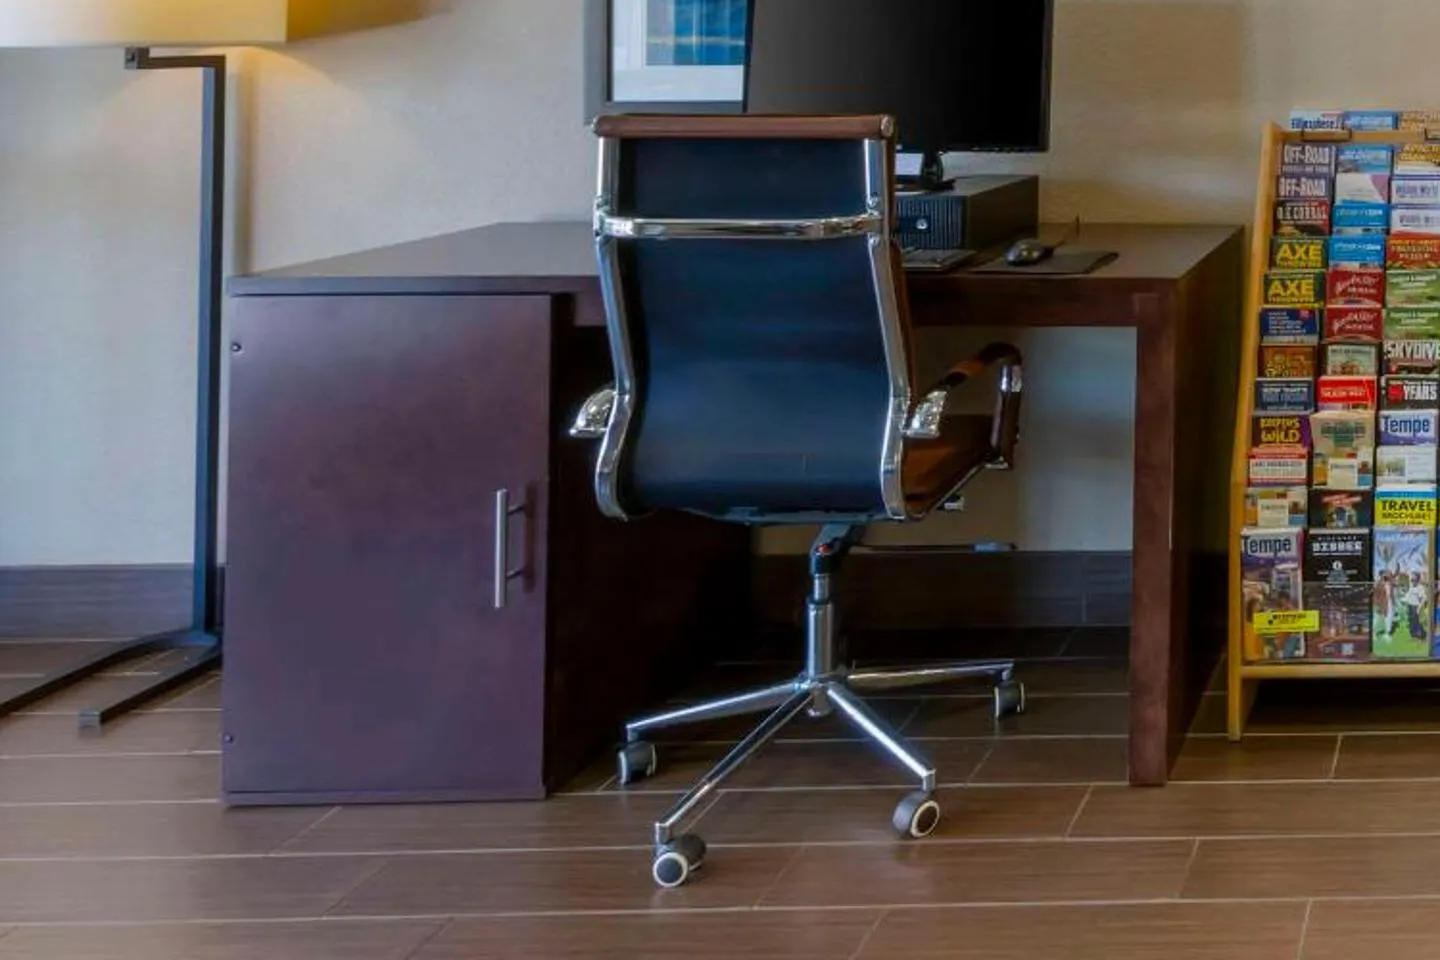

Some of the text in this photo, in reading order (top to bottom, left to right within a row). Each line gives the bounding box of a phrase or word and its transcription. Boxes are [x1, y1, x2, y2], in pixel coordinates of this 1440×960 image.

[1277, 243, 1321, 260] AXE
[1268, 280, 1313, 296] AXE
[1404, 383, 1438, 400] YEARS
[1382, 415, 1430, 436] Tempe
[1381, 501, 1434, 512] TRAVEL
